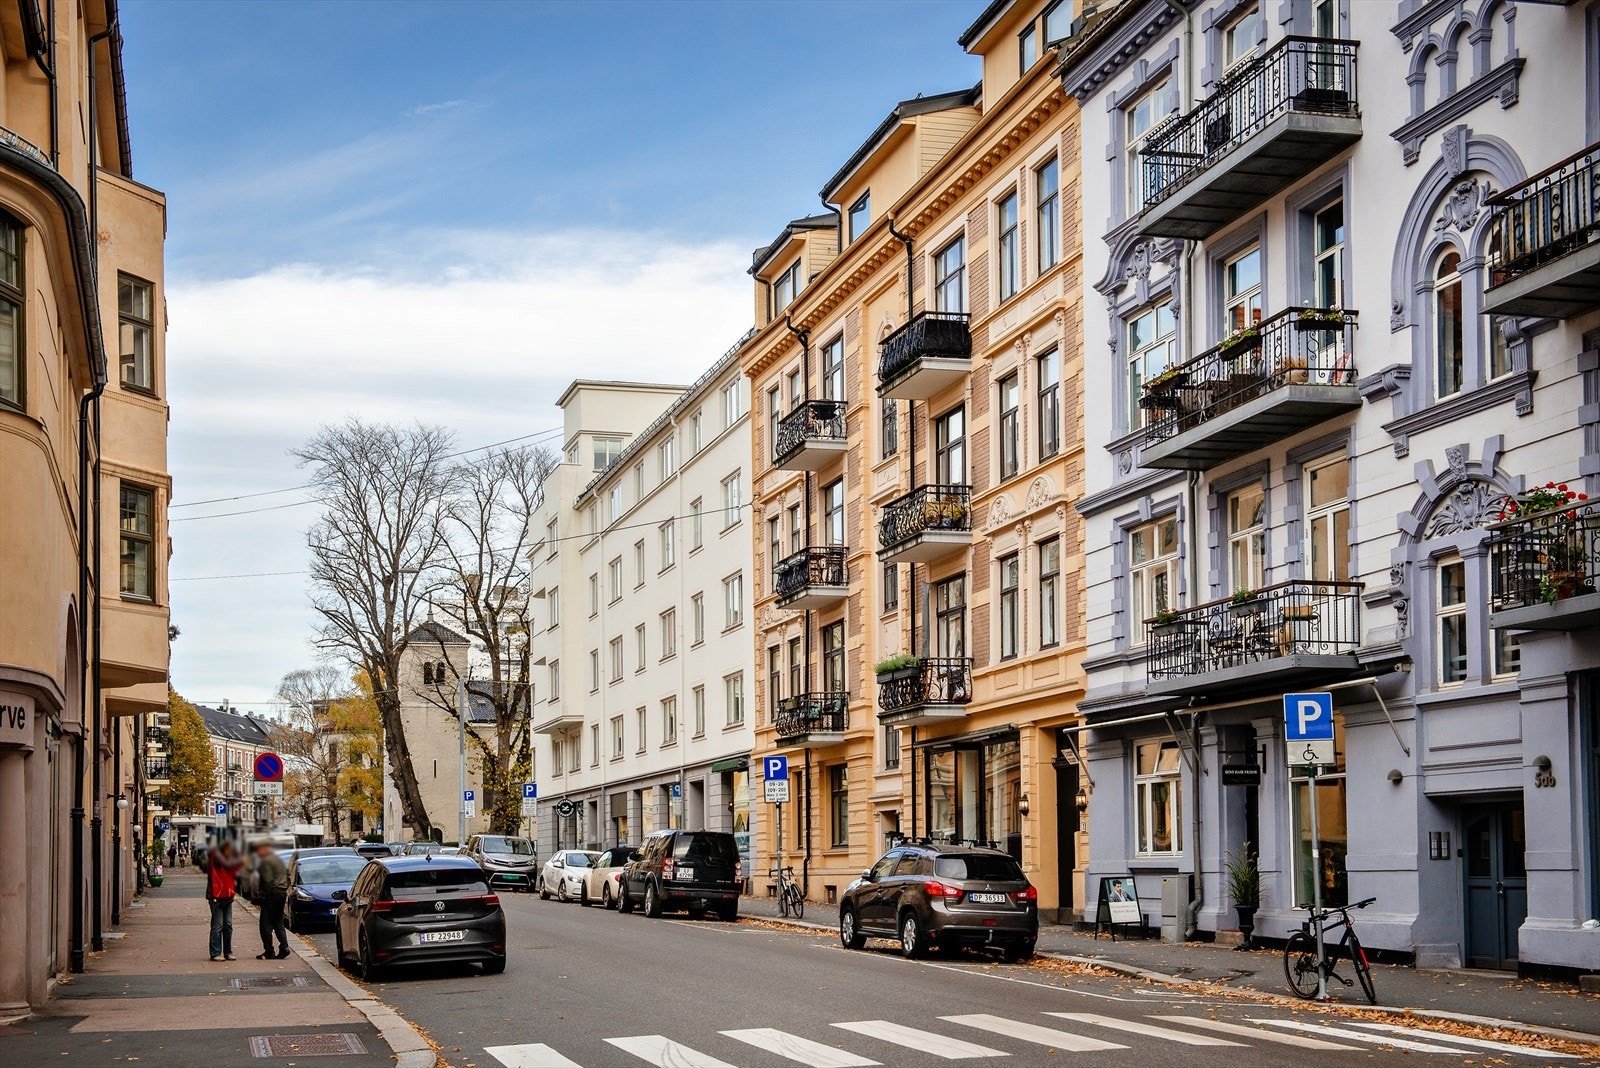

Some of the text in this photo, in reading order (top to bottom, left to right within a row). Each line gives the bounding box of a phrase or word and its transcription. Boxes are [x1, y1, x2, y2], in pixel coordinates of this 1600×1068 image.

[0, 704, 26, 730] rve
[1297, 700, 1322, 735] P
[769, 759, 782, 778] P
[466, 791, 472, 800] P
[526, 785, 534, 796] P
[217, 804, 225, 813] P
[426, 931, 461, 941] EF 22948
